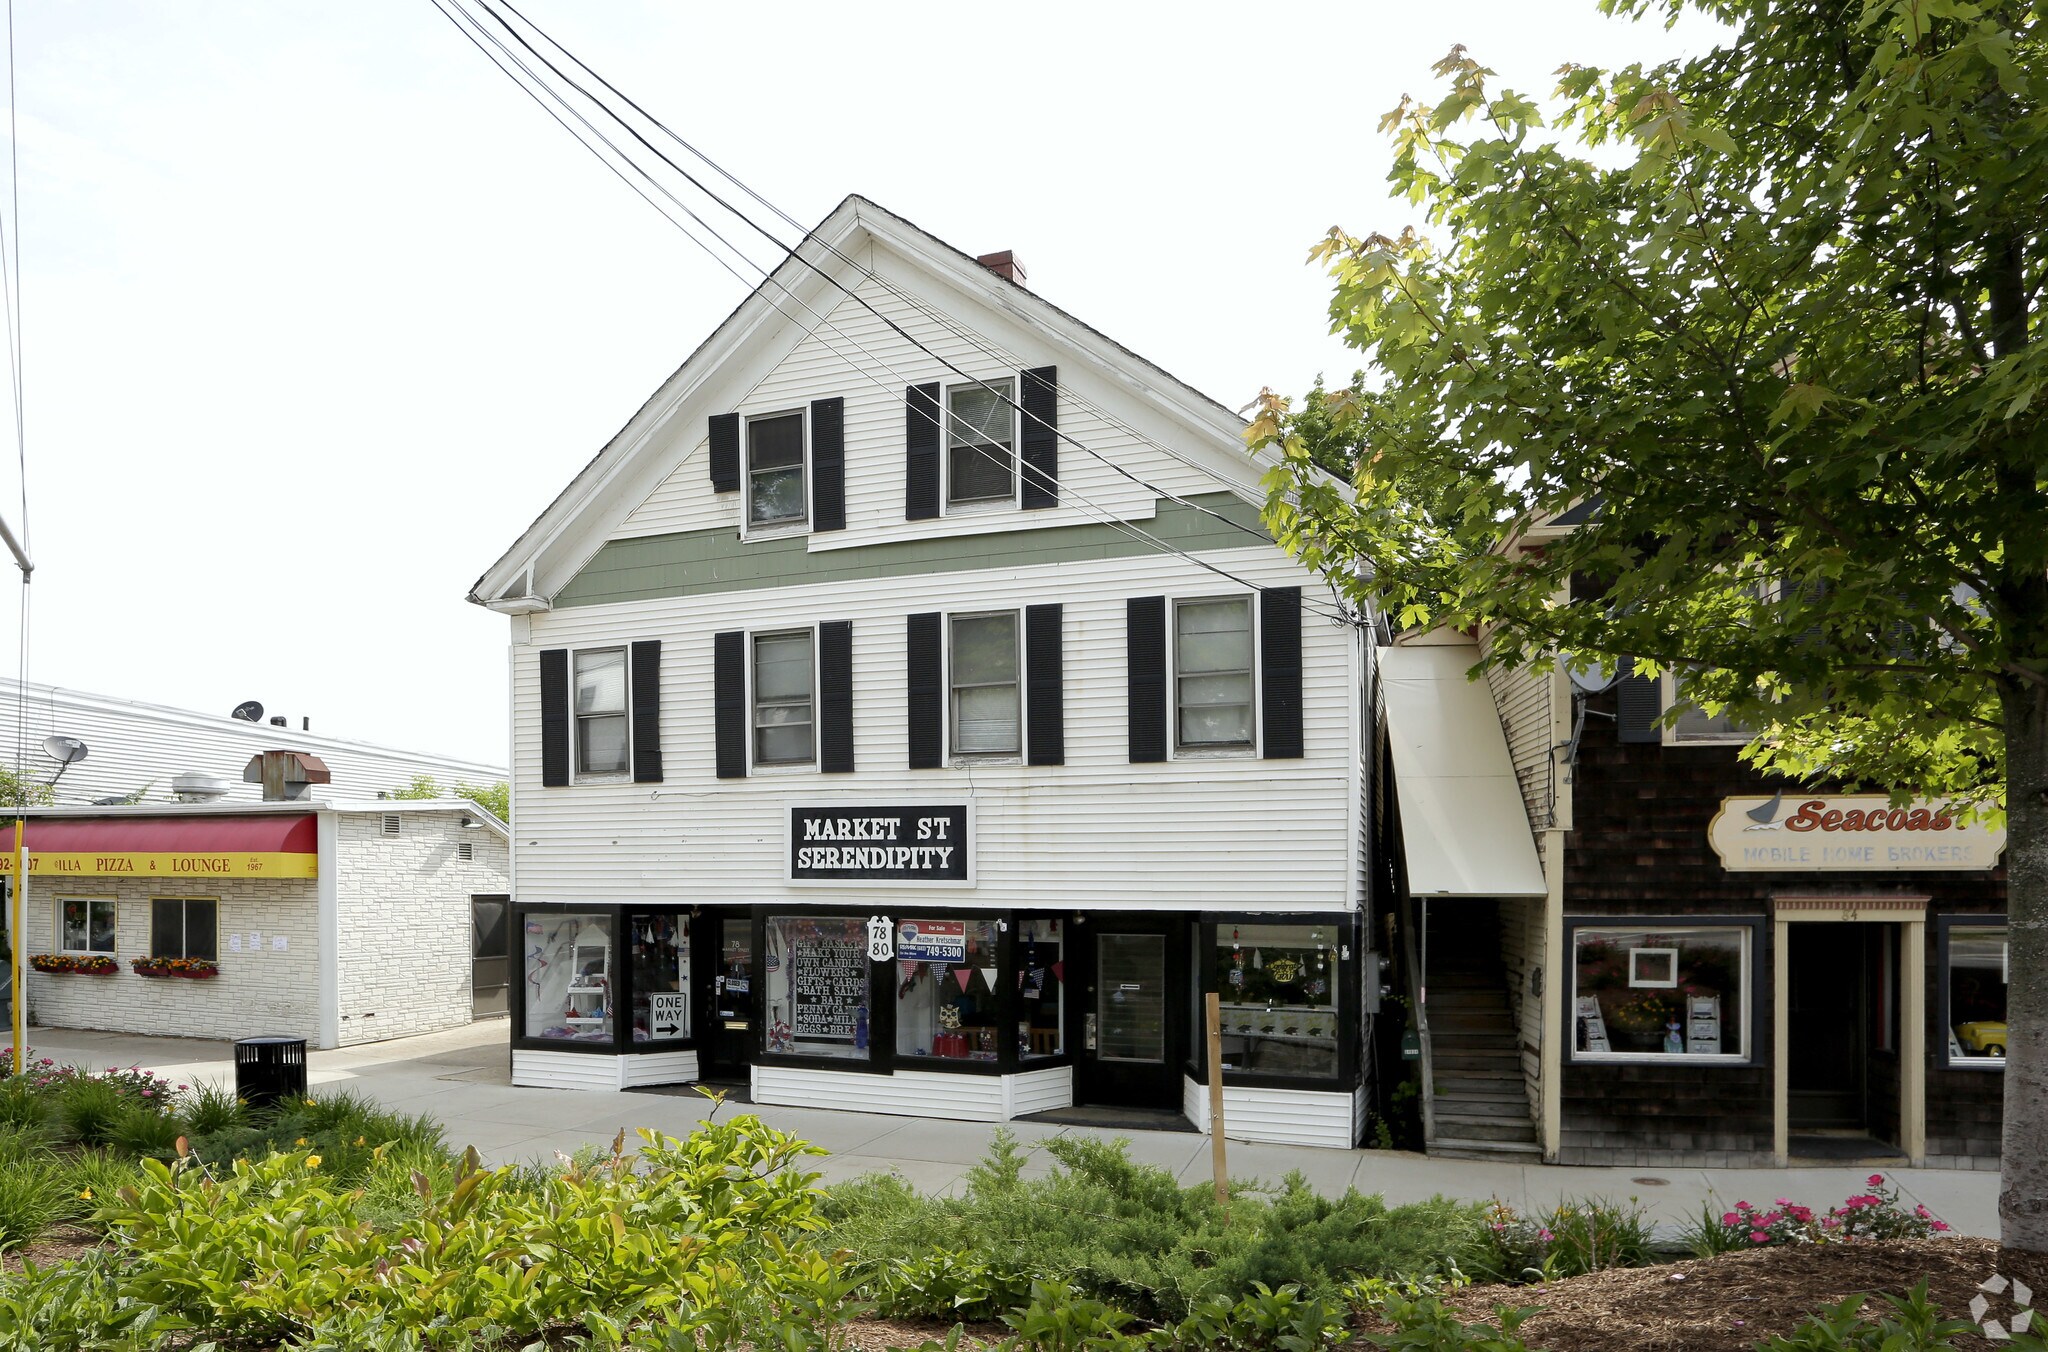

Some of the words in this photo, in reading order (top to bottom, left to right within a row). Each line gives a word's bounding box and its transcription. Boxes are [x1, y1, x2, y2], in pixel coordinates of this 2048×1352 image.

[1785, 800, 1967, 832] Seacoas
[803, 817, 900, 841] MARKET
[917, 817, 951, 840] ST
[798, 846, 954, 869] SERENDIPITY
[1744, 846, 1810, 862] MOBILE
[1887, 844, 1975, 862] BROKERS
[96, 858, 134, 872] PIZZA
[149, 860, 156, 870] &
[172, 858, 231, 872] LOUNGE
[247, 863, 263, 871] 1967
[872, 926, 887, 940] 78
[731, 940, 740, 948] 78
[916, 935, 934, 944] Heather
[802, 948, 831, 958] MAKE
[833, 948, 861, 959] YOUR
[872, 942, 889, 956] 80
[926, 945, 962, 957] 749-5300
[796, 957, 820, 967] OWN
[822, 958, 864, 968] CANDLES
[803, 967, 850, 977] FLOWERS
[797, 976, 825, 986] GIFTS
[832, 977, 865, 987] CARDS
[803, 986, 831, 995] BATH
[834, 986, 859, 996] SALT
[656, 997, 682, 1008] ONE
[820, 995, 843, 1005] BAR
[797, 1004, 831, 1014] PENNY
[655, 1009, 682, 1021] WAY
[803, 1014, 828, 1024] SODA
[833, 1015, 858, 1025] MILK
[796, 1023, 821, 1033] EGGS
